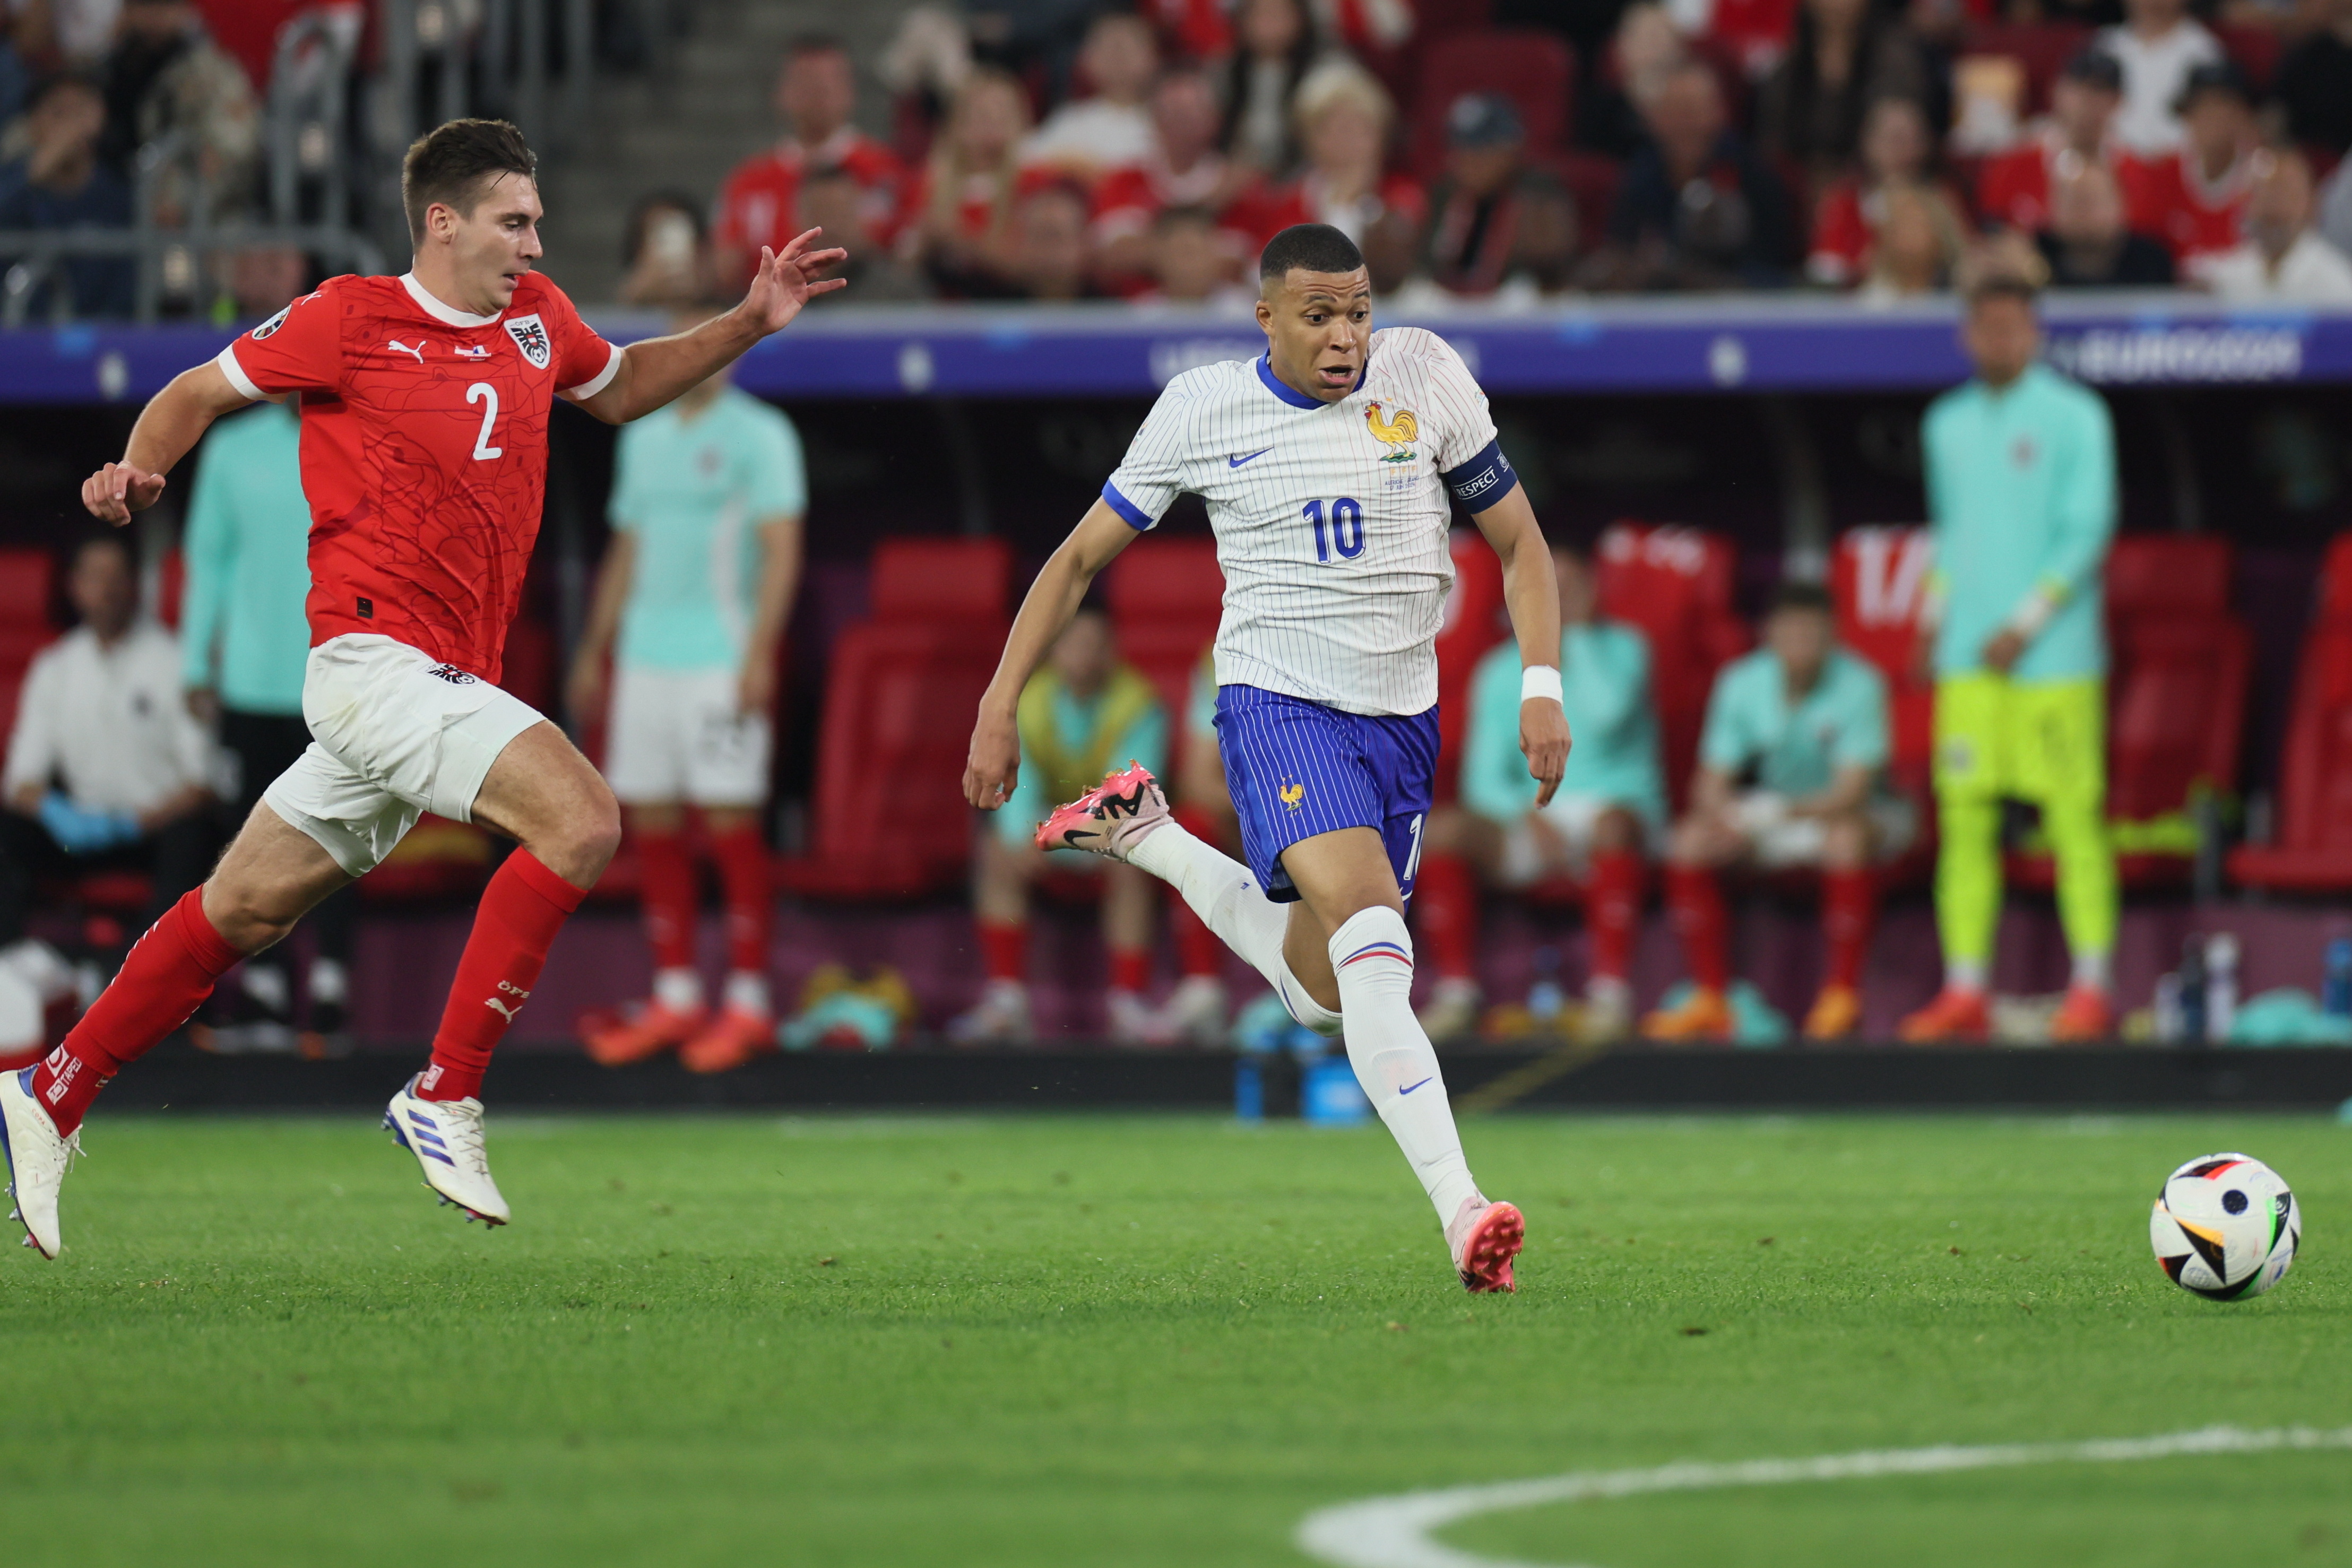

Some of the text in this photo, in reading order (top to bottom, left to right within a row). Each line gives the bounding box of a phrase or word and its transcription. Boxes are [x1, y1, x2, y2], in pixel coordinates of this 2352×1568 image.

[466, 382, 503, 461] 2
[1456, 469, 1495, 497] RESPECT
[1302, 497, 1367, 564] 10
[32, 1108, 45, 1125] COPA
